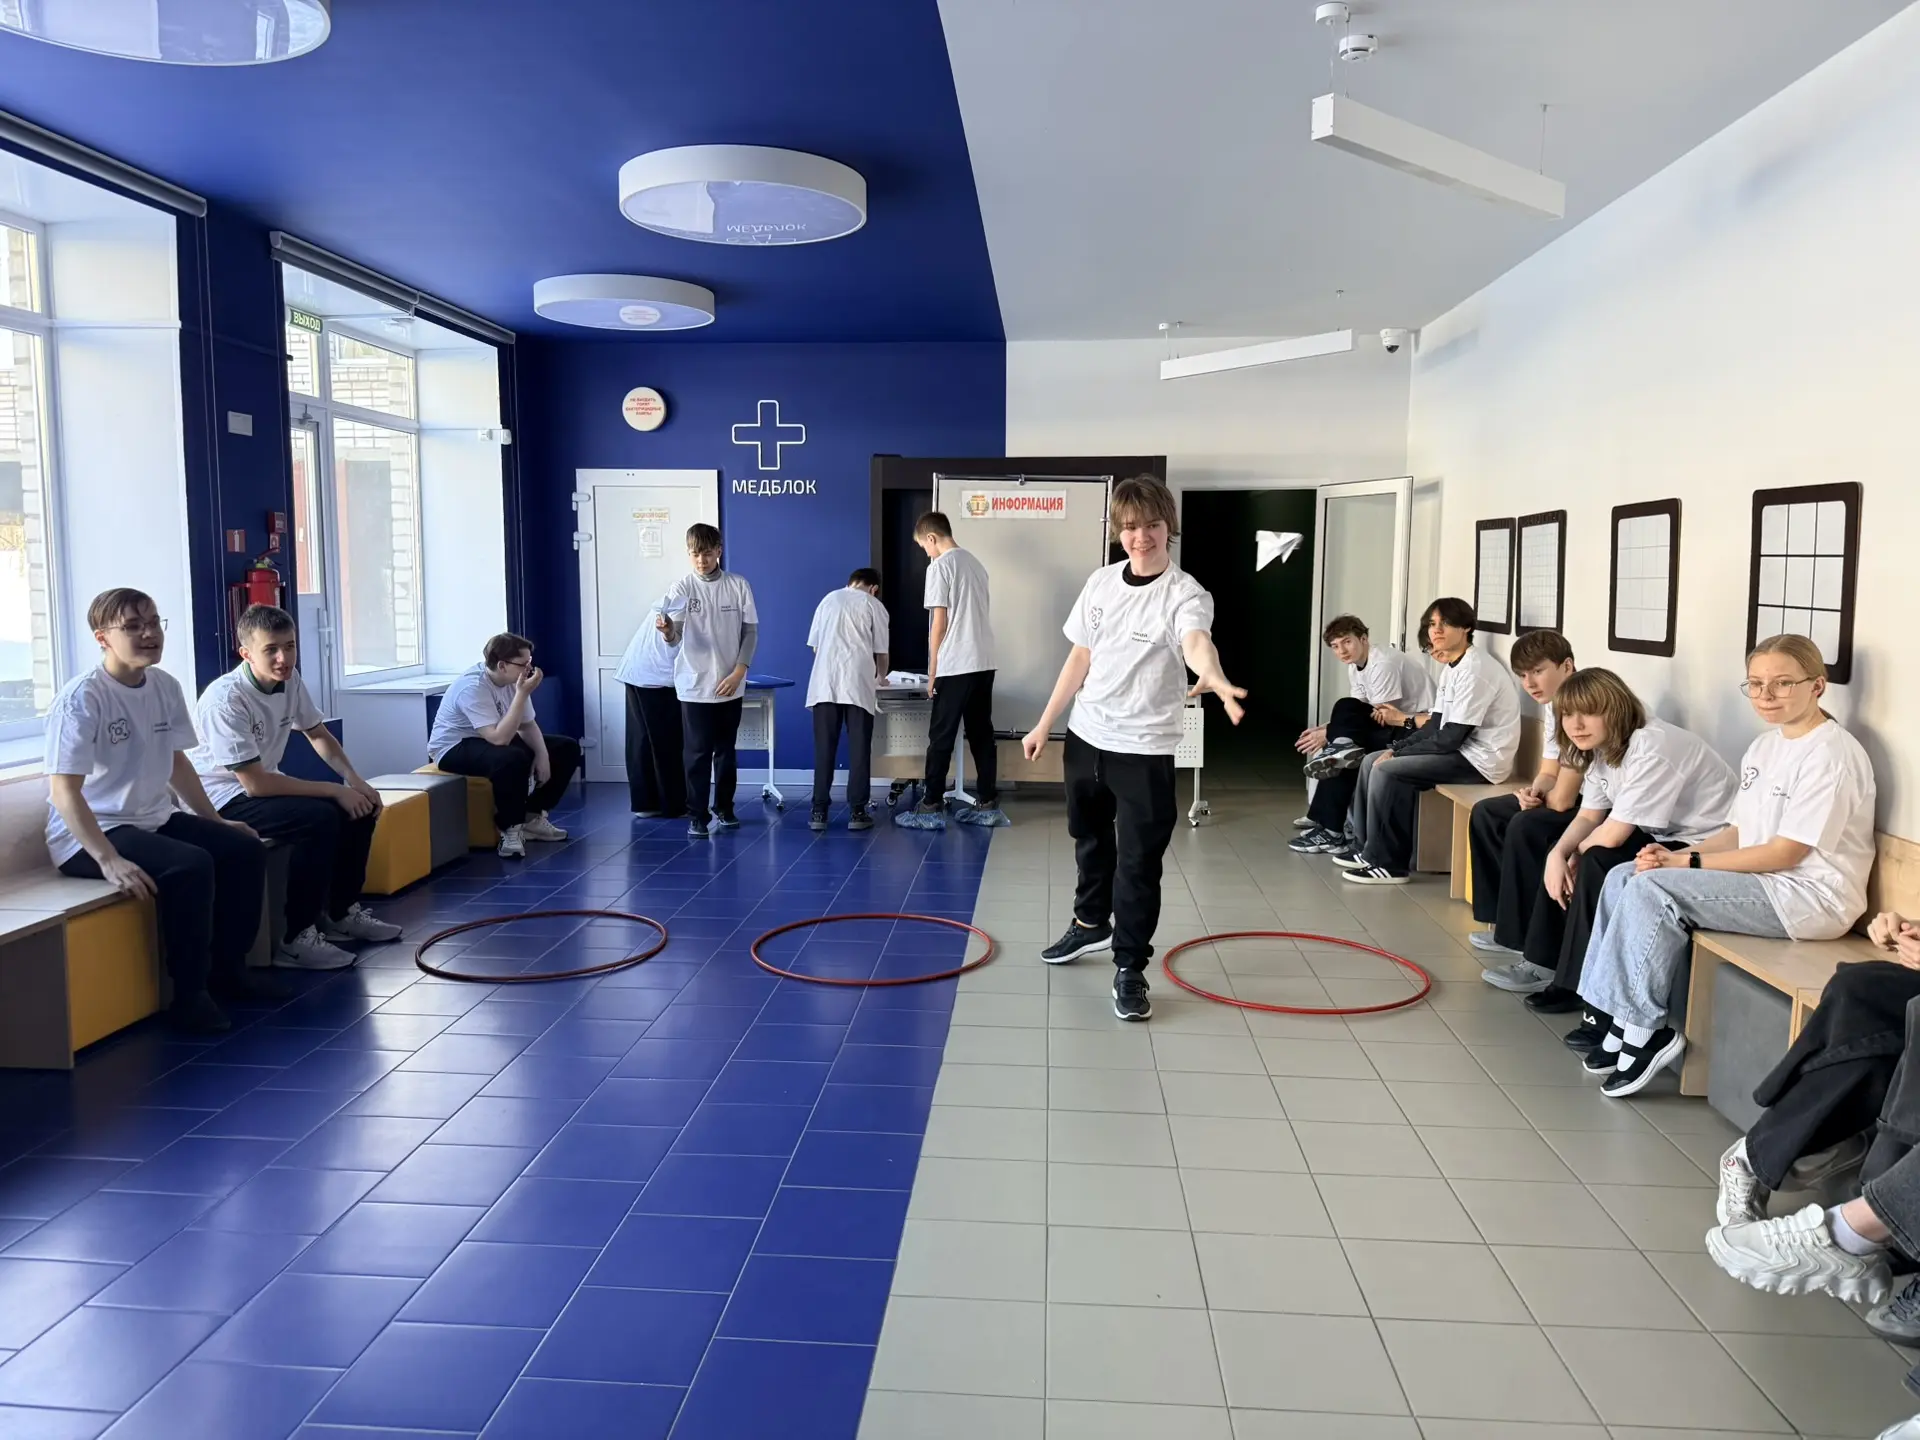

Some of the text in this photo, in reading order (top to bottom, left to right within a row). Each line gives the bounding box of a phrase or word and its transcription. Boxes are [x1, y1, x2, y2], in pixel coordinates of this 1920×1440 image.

[293, 311, 321, 332] ВЫХОД
[732, 479, 816, 497] МЕДБЛОК
[991, 497, 1064, 513] ИНФОРМАЦИЯ
